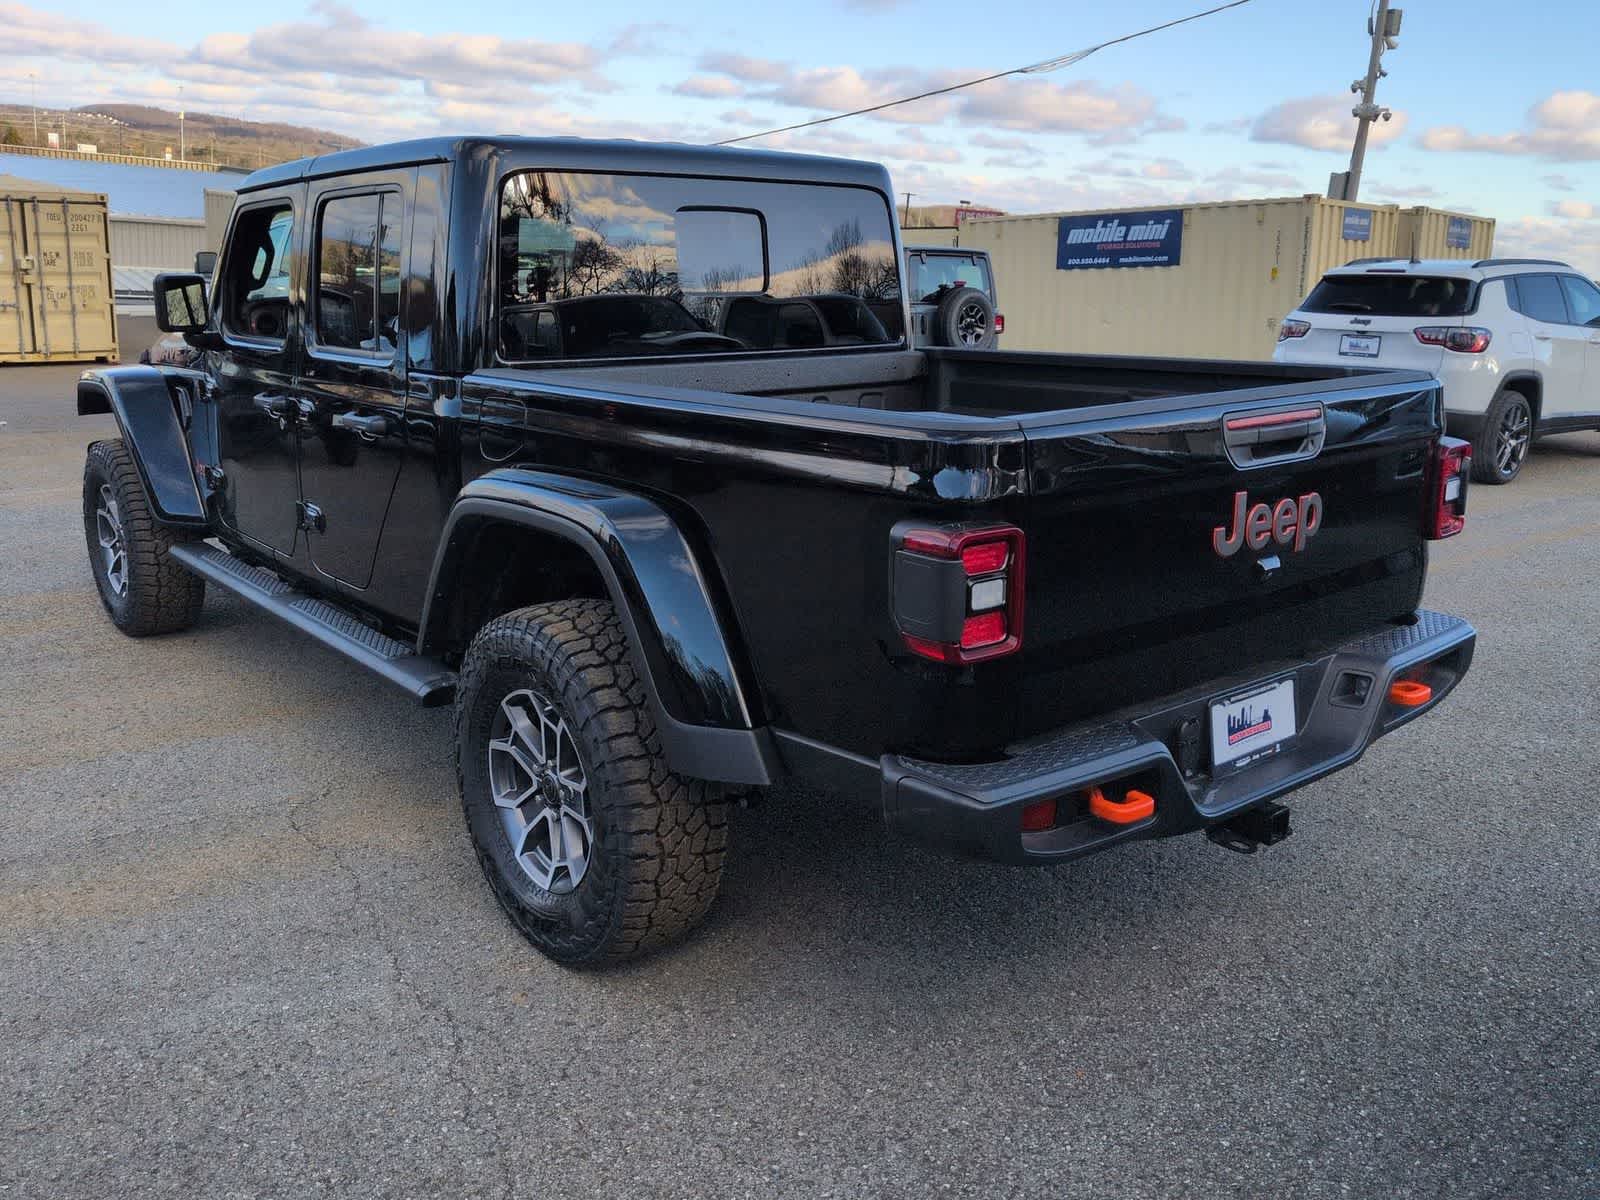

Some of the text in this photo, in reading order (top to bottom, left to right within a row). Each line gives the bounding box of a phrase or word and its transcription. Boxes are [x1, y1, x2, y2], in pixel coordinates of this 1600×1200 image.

[1066, 219, 1171, 244] mobile mini
[1212, 491, 1323, 557] Jeep
